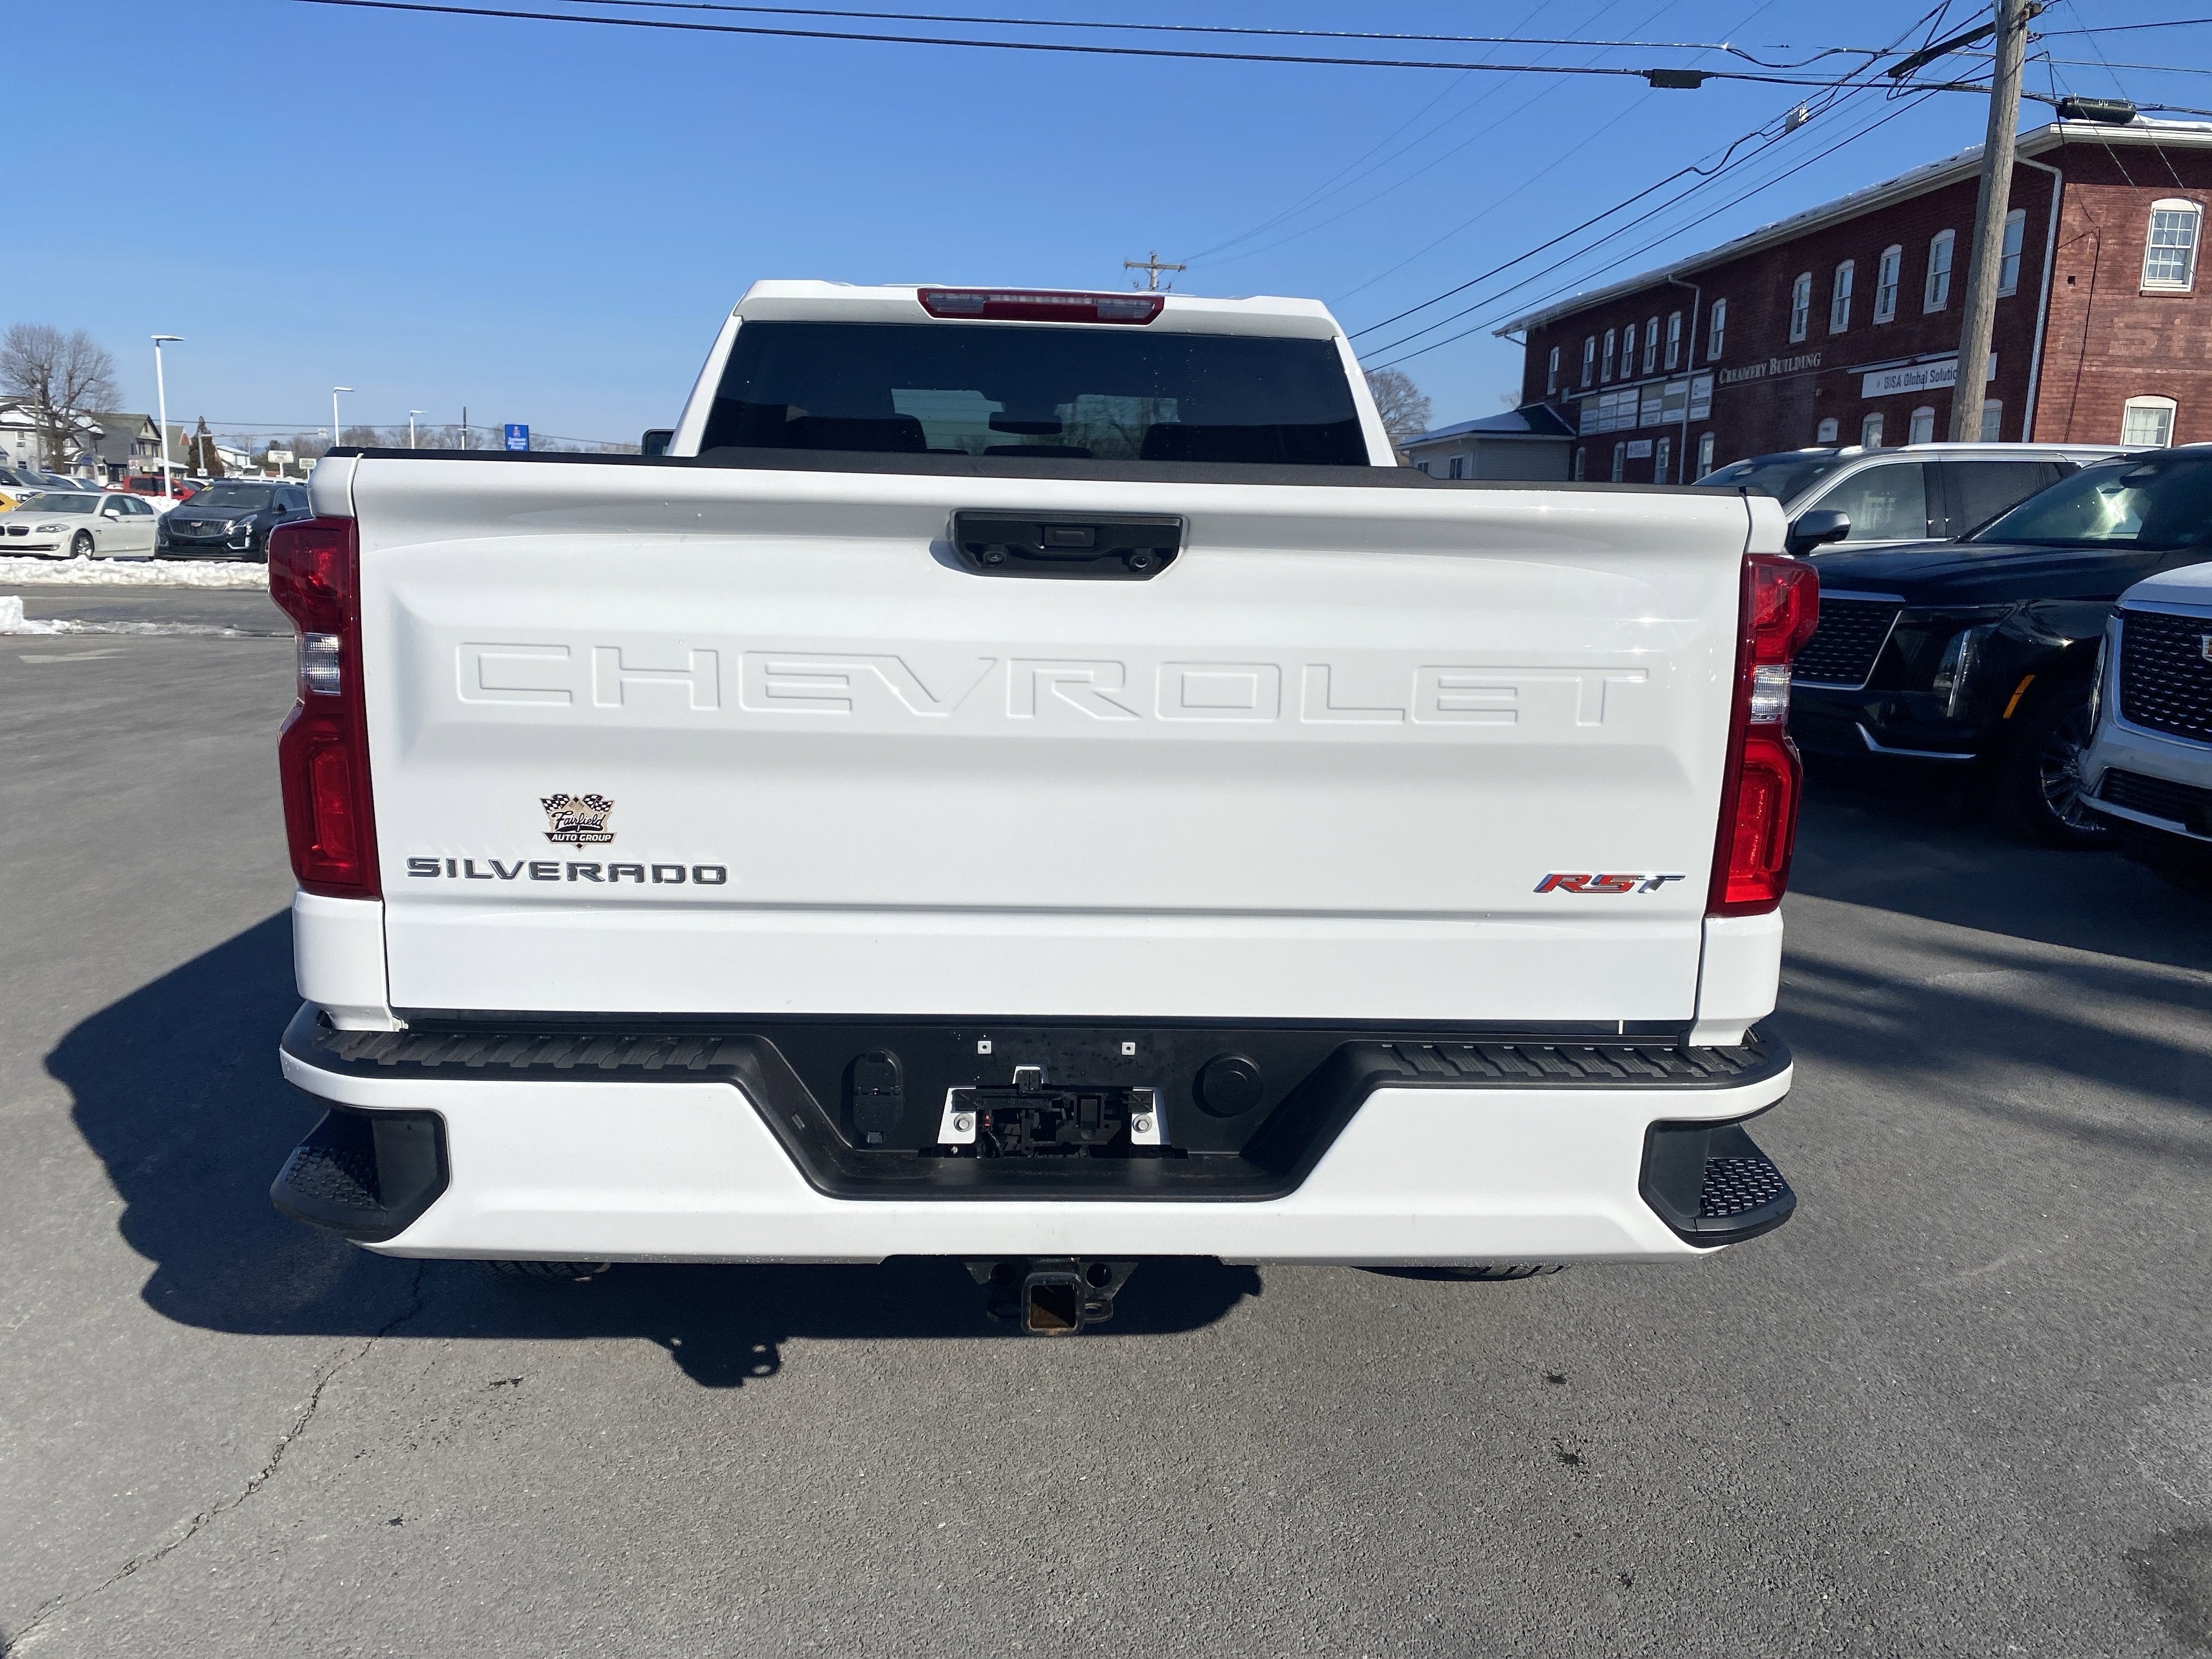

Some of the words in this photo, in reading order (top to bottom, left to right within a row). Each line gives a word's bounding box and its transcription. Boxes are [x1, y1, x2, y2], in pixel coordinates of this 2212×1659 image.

[1719, 363, 1767, 384] CREAMERY
[1769, 353, 1821, 375] BUILDING
[1904, 370, 1928, 386] Global
[1929, 366, 1958, 383] Solutio
[456, 642, 1650, 726] CHEVROLET
[551, 810, 606, 832] Fairfield
[407, 856, 729, 884] SILVERADO
[1533, 873, 1686, 893] RST
